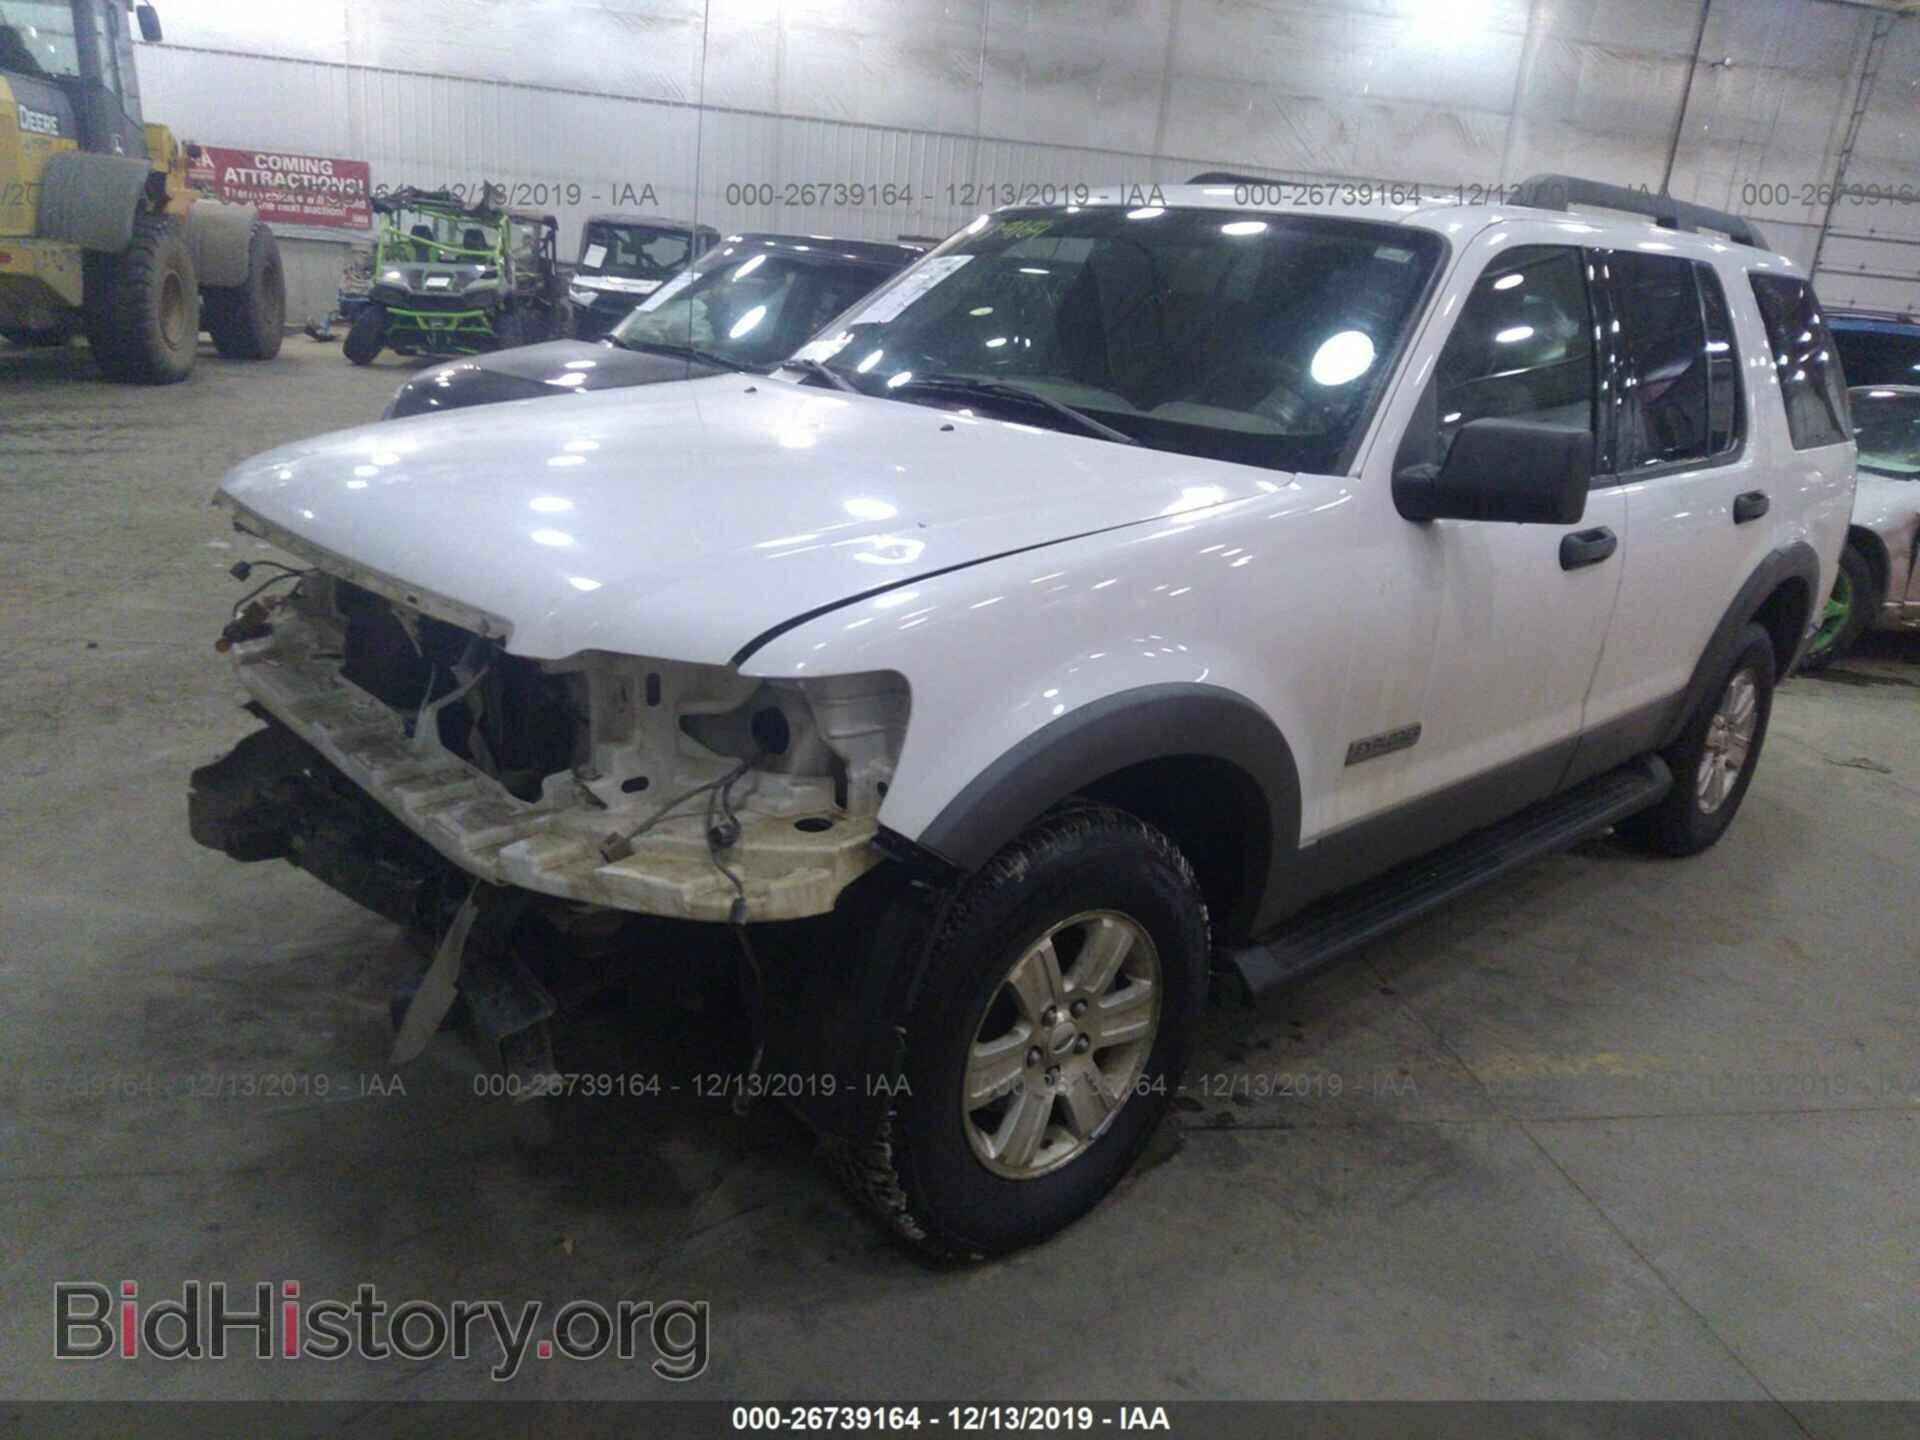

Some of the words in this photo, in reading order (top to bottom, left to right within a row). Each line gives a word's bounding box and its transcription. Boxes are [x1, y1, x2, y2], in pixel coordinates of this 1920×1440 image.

[19, 103, 59, 136] DEERE
[255, 153, 333, 176] COMING
[224, 167, 364, 195] ATTRACTIONS!
